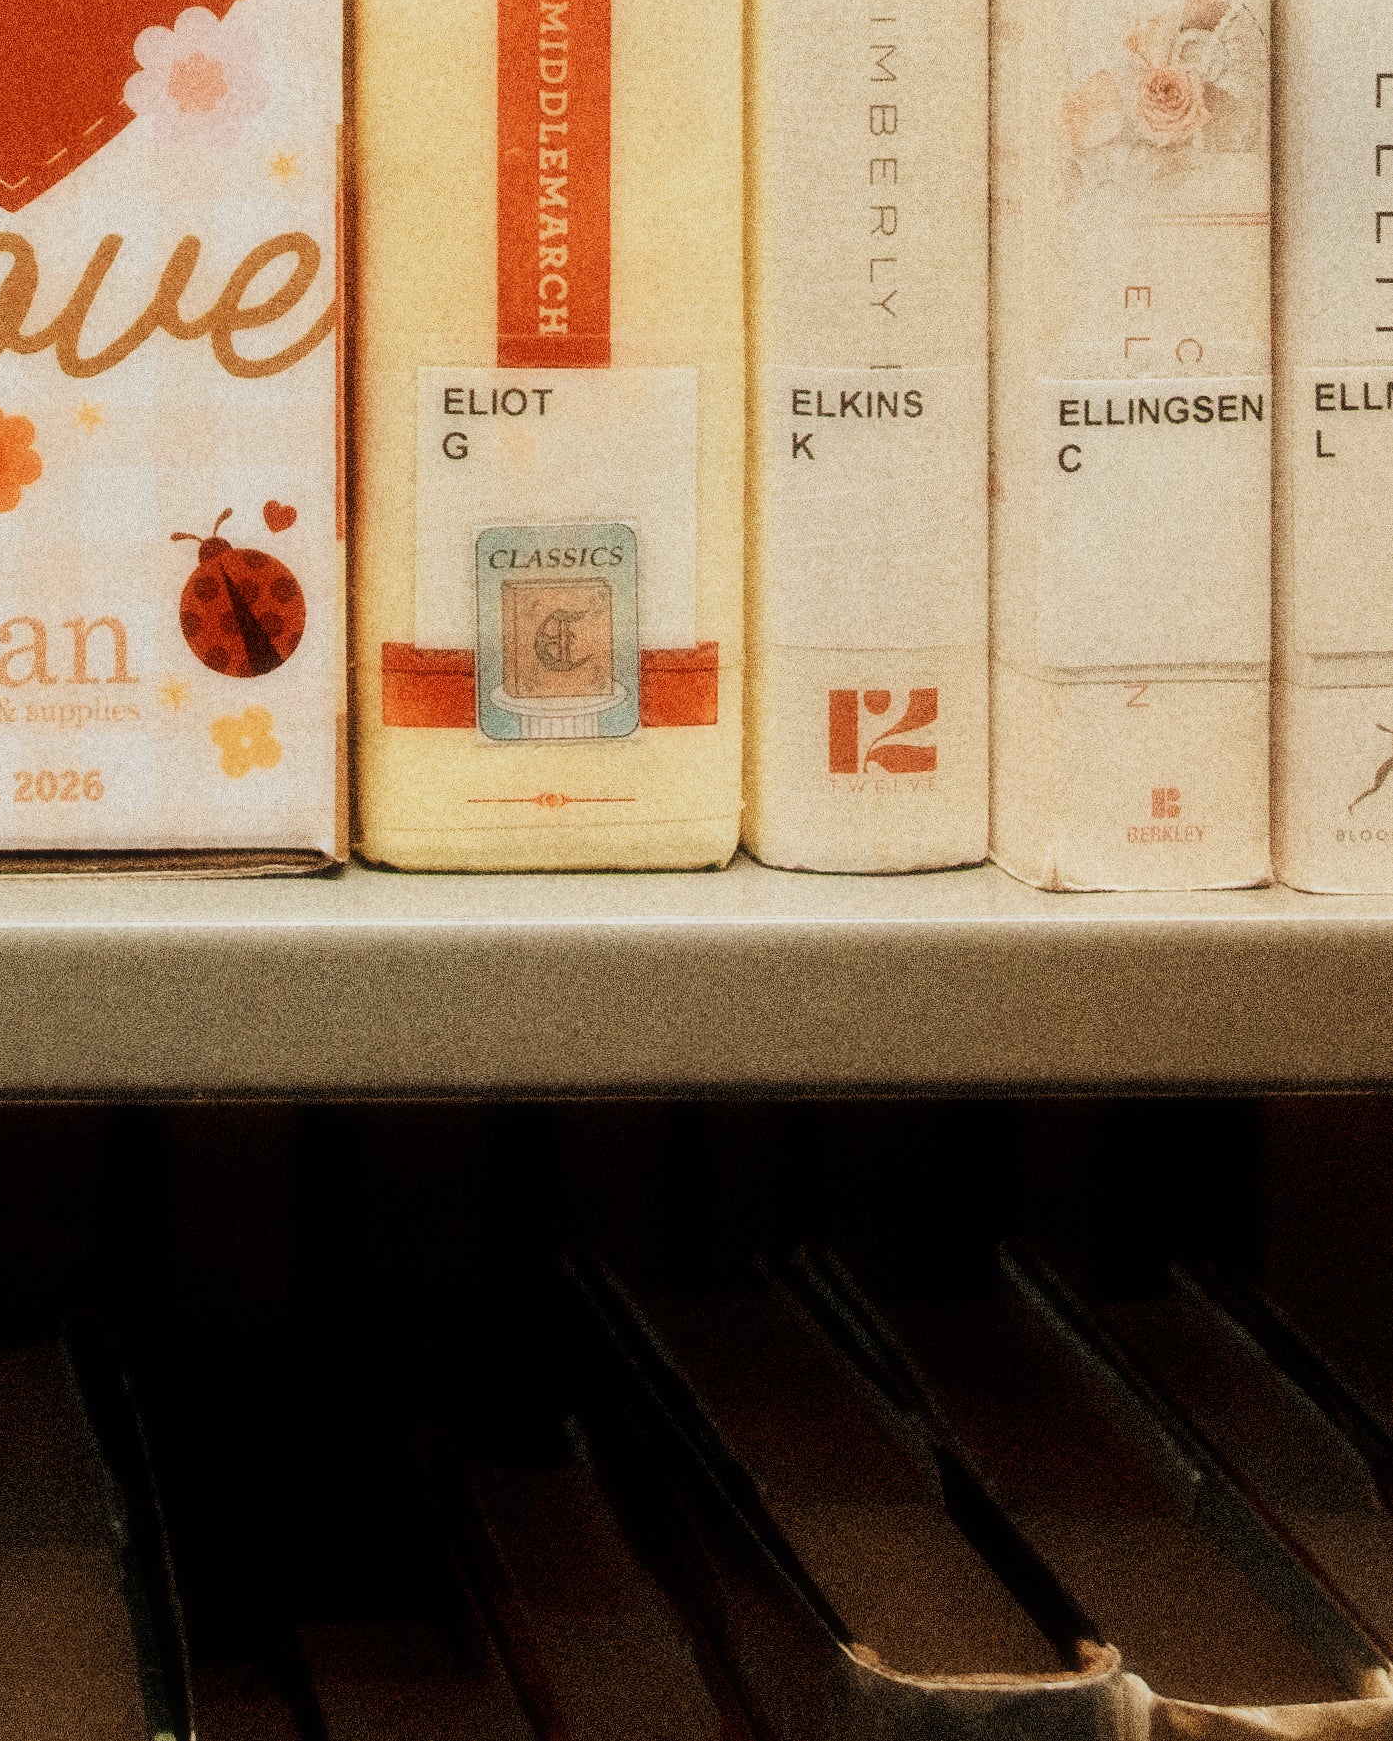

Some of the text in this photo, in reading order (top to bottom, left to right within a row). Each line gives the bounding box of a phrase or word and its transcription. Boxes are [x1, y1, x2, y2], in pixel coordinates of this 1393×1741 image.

[536, 0, 570, 337] MIDDLEMARCH
[442, 386, 554, 418] ELIOT
[791, 389, 925, 419] ELKINS
[1058, 394, 1265, 427] ELLINGSEN
[441, 431, 470, 461] G
[791, 432, 816, 461] K
[1057, 443, 1083, 473] C
[1315, 428, 1336, 459] L
[488, 545, 625, 571] CLASSICS
[12, 768, 105, 803] 2026
